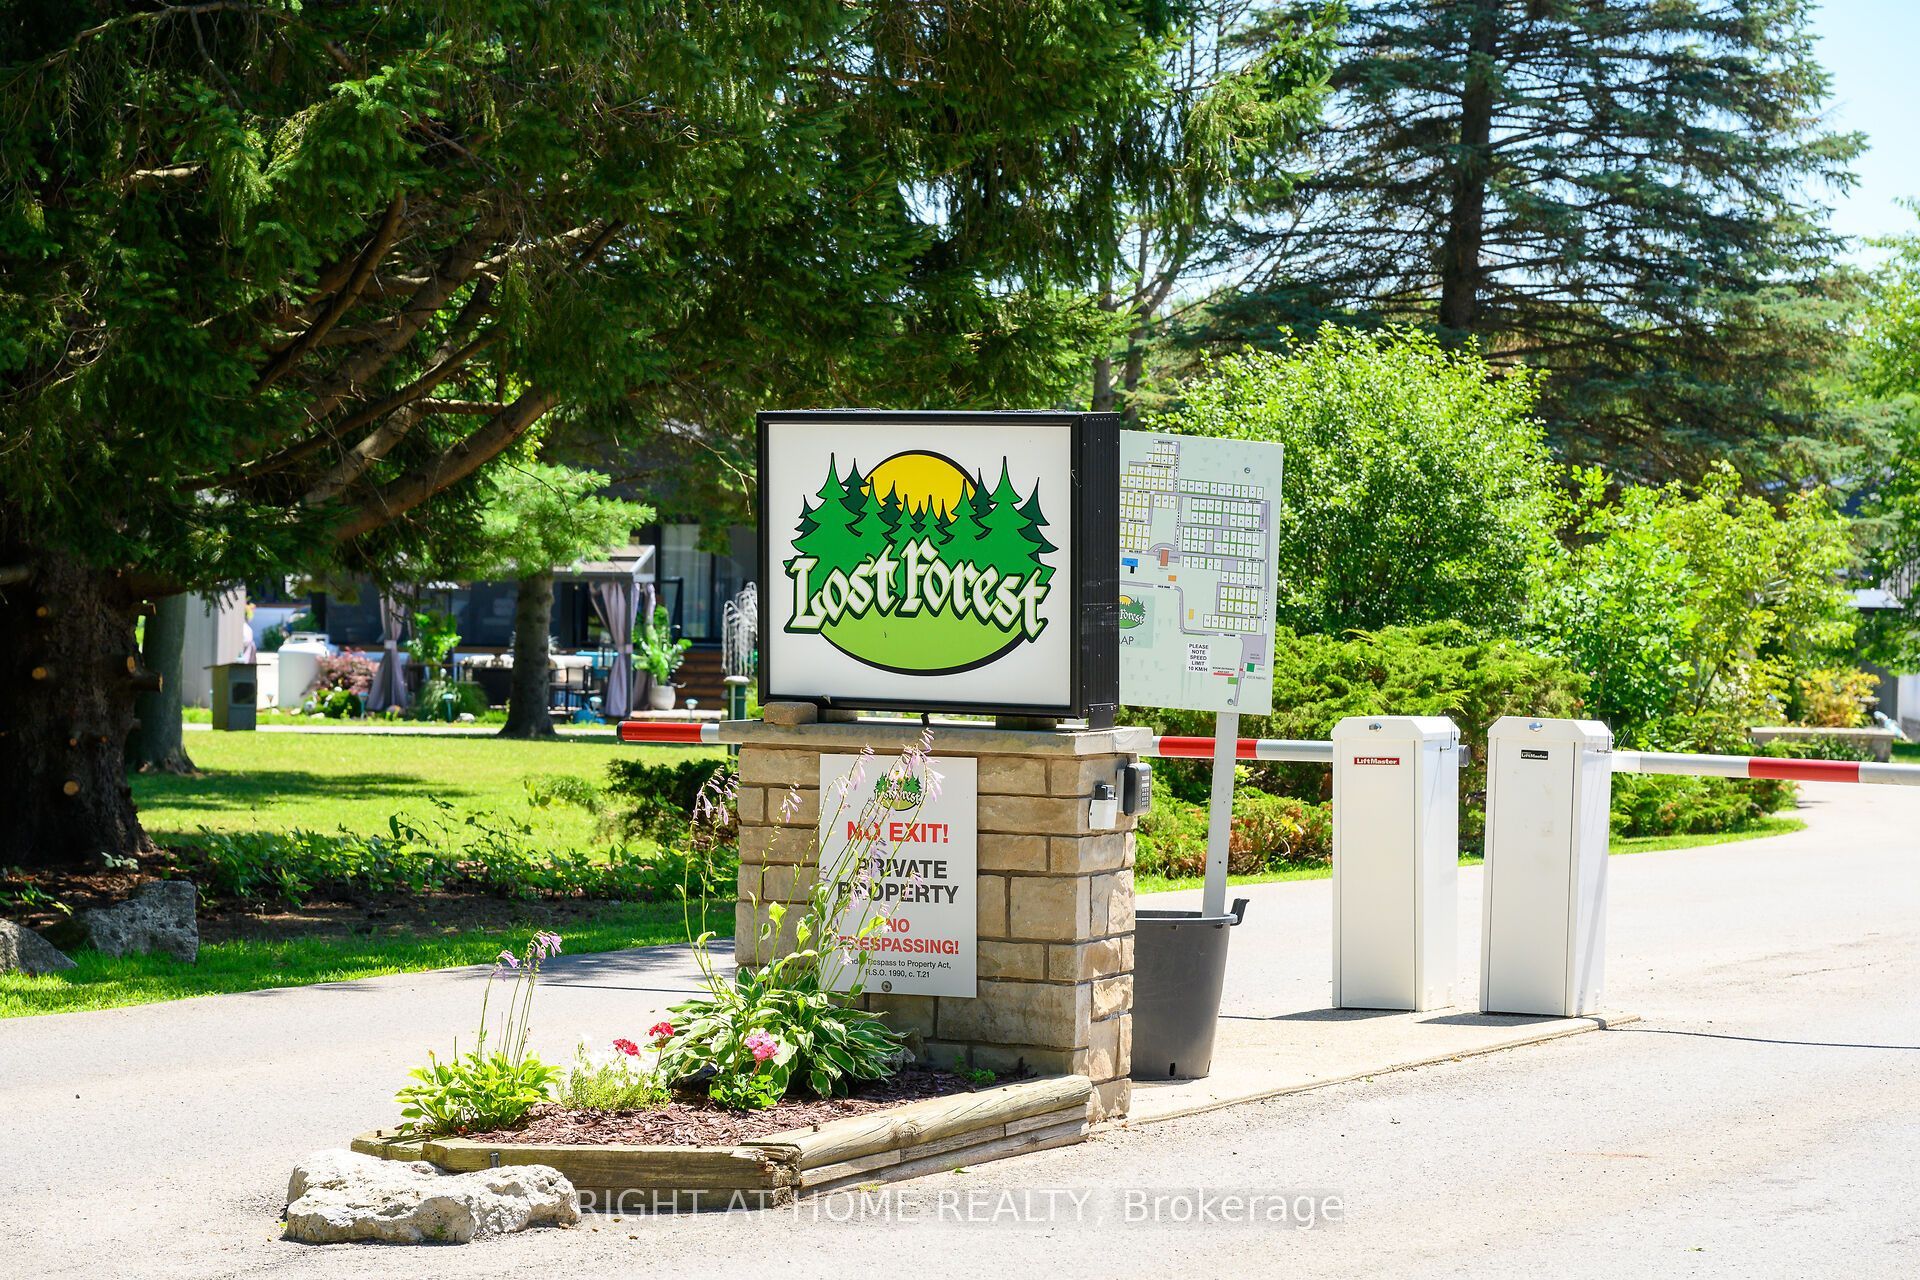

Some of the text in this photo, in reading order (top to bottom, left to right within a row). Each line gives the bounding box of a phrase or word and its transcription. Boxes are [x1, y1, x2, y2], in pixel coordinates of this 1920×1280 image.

[785, 537, 1051, 641] Lost Forest
[1120, 636, 1134, 646] AP
[847, 821, 949, 843] NO EXIT!
[857, 858, 948, 879] PRIVATE
[886, 918, 911, 933] NO
[907, 960, 936, 969] Property
[937, 962, 952, 970] Act,
[889, 970, 907, 979] 1990,
[916, 970, 931, 978] T.21
